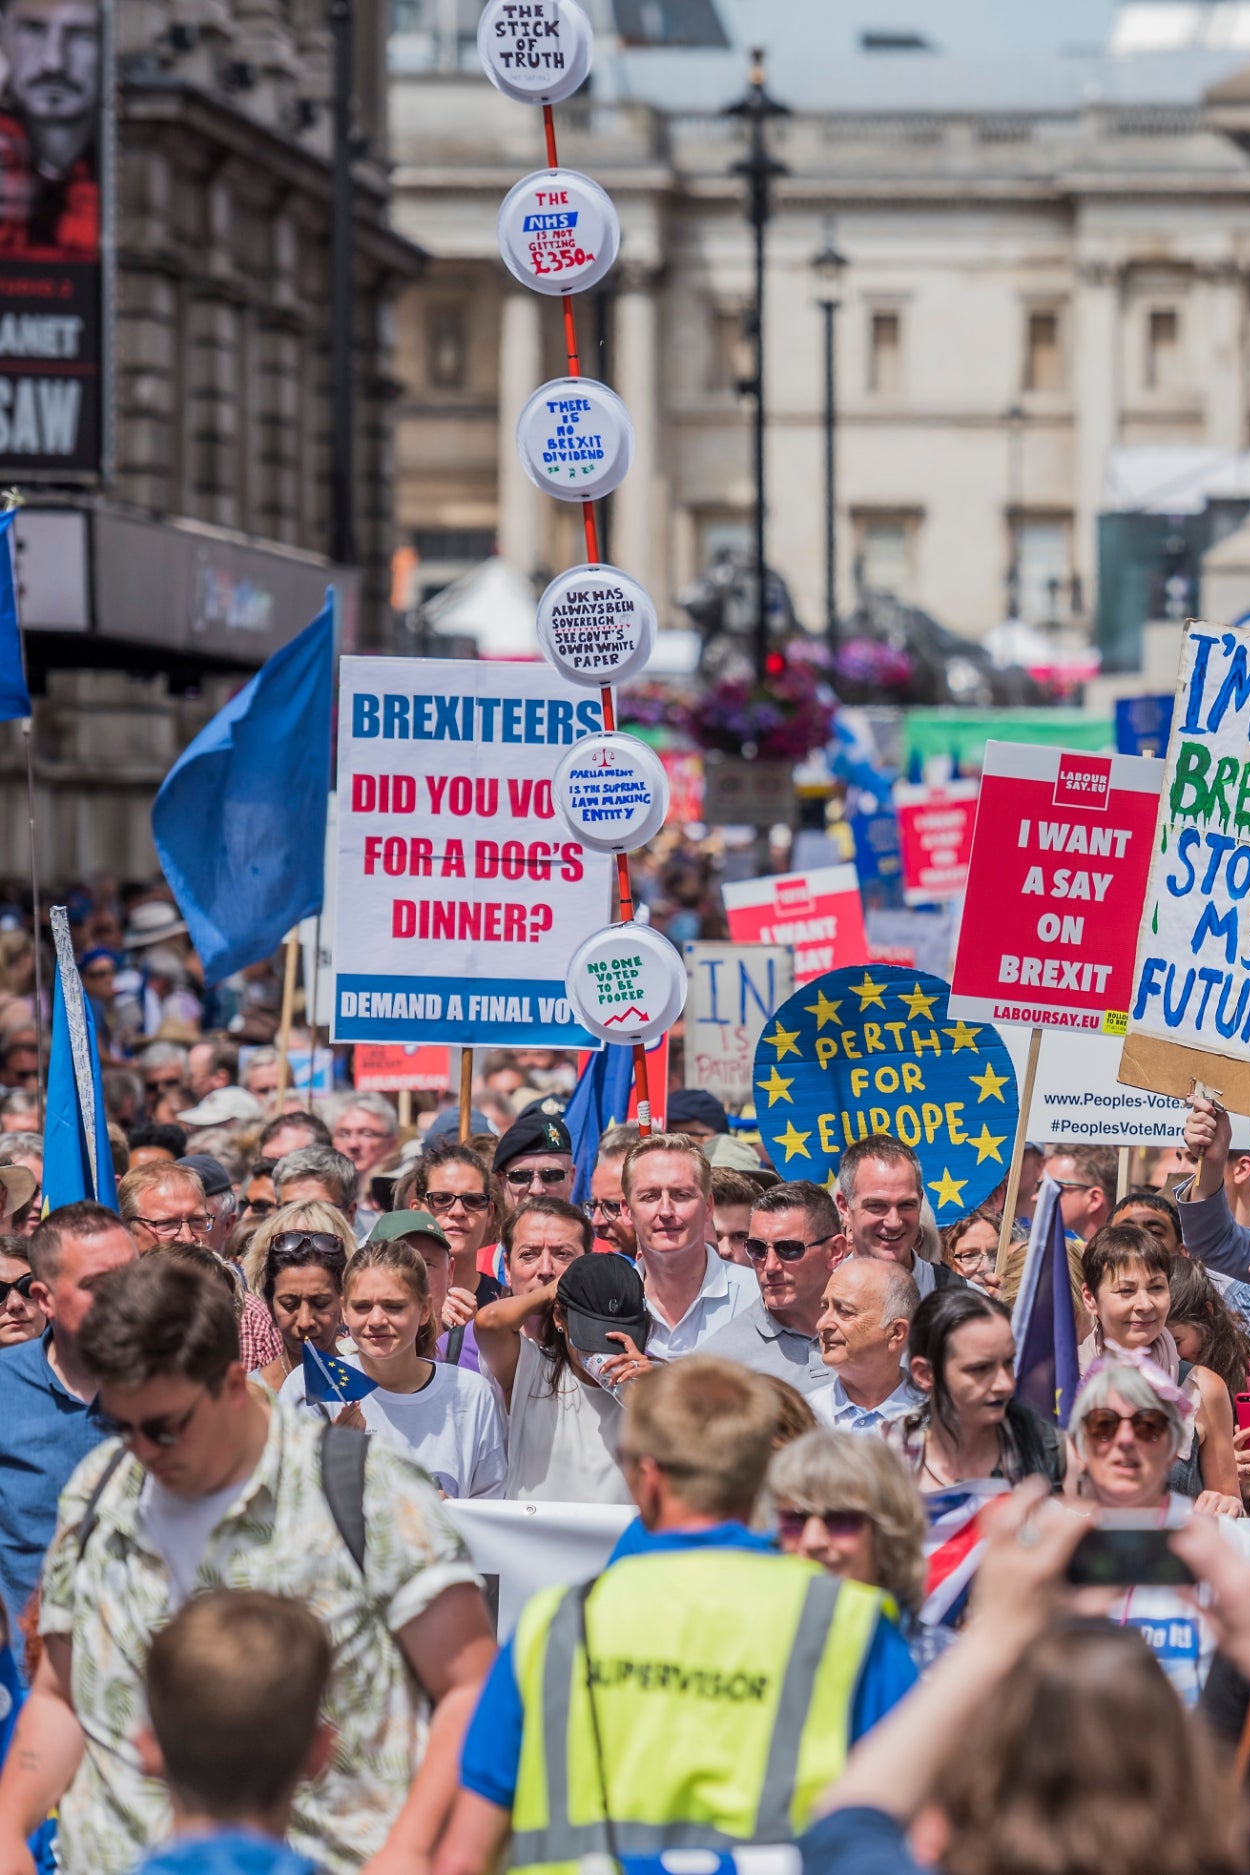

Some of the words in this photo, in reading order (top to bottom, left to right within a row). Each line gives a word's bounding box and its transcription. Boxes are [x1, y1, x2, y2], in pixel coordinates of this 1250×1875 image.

[503, 5, 544, 18] THE
[495, 20, 560, 37] STICK
[516, 38, 537, 51] OF
[500, 52, 564, 69] TRUTH
[535, 191, 568, 206] THE
[528, 214, 569, 230] NHS
[536, 231, 547, 240] IS
[553, 229, 573, 239] NOT
[546, 399, 591, 413] THERE
[562, 412, 580, 424] IS
[556, 425, 574, 436] NO
[547, 435, 602, 449] BREXIT
[543, 449, 604, 463] DIVIDEND
[566, 591, 589, 604] UK
[592, 587, 624, 602] HAS
[552, 603, 604, 617] ALWAYS
[606, 600, 634, 613] BEEN
[552, 616, 614, 630] SOVEREIGN
[555, 632, 576, 644] SEE
[578, 629, 624, 643] GOVT'S
[559, 643, 594, 655] OWN
[595, 640, 635, 654] WHITE
[573, 653, 618, 668] PAPER
[352, 693, 602, 745] BREXITEERS
[569, 769, 634, 779] PARLIAMENT
[1060, 770, 1107, 784] LABOUR
[569, 785, 581, 794] IS
[583, 785, 600, 793] THE
[602, 781, 646, 793] SUPREME
[1065, 780, 1107, 793] SAY.EU
[352, 774, 416, 814] DID
[425, 775, 499, 818] YOU
[571, 797, 599, 808] LAW
[602, 793, 651, 805] MAKING
[582, 808, 635, 821] ENTITY
[1017, 819, 1031, 849] I
[1038, 821, 1132, 858] WANT
[363, 836, 432, 876] FOR
[440, 839, 466, 878] A
[475, 840, 584, 883] DOG'S
[1021, 866, 1045, 896] A
[1051, 868, 1114, 902] SAY
[392, 899, 553, 943] DINNER?
[1037, 913, 1084, 945] ON
[587, 961, 607, 974] NO
[611, 955, 643, 970] ONE
[595, 969, 639, 982] VOTED
[998, 954, 1112, 994] BREXIT
[597, 983, 612, 993] TO
[617, 980, 634, 990] BE
[696, 957, 775, 1025] IN
[598, 989, 644, 1005] POORER
[340, 991, 442, 1021] DEMAND
[446, 994, 466, 1021] A
[468, 996, 534, 1024] FINAL
[993, 1005, 1101, 1029] LABOURSAY.EU
[814, 1021, 942, 1071] PERTH
[850, 1062, 926, 1098] FOR
[817, 1102, 970, 1154] EUROPE
